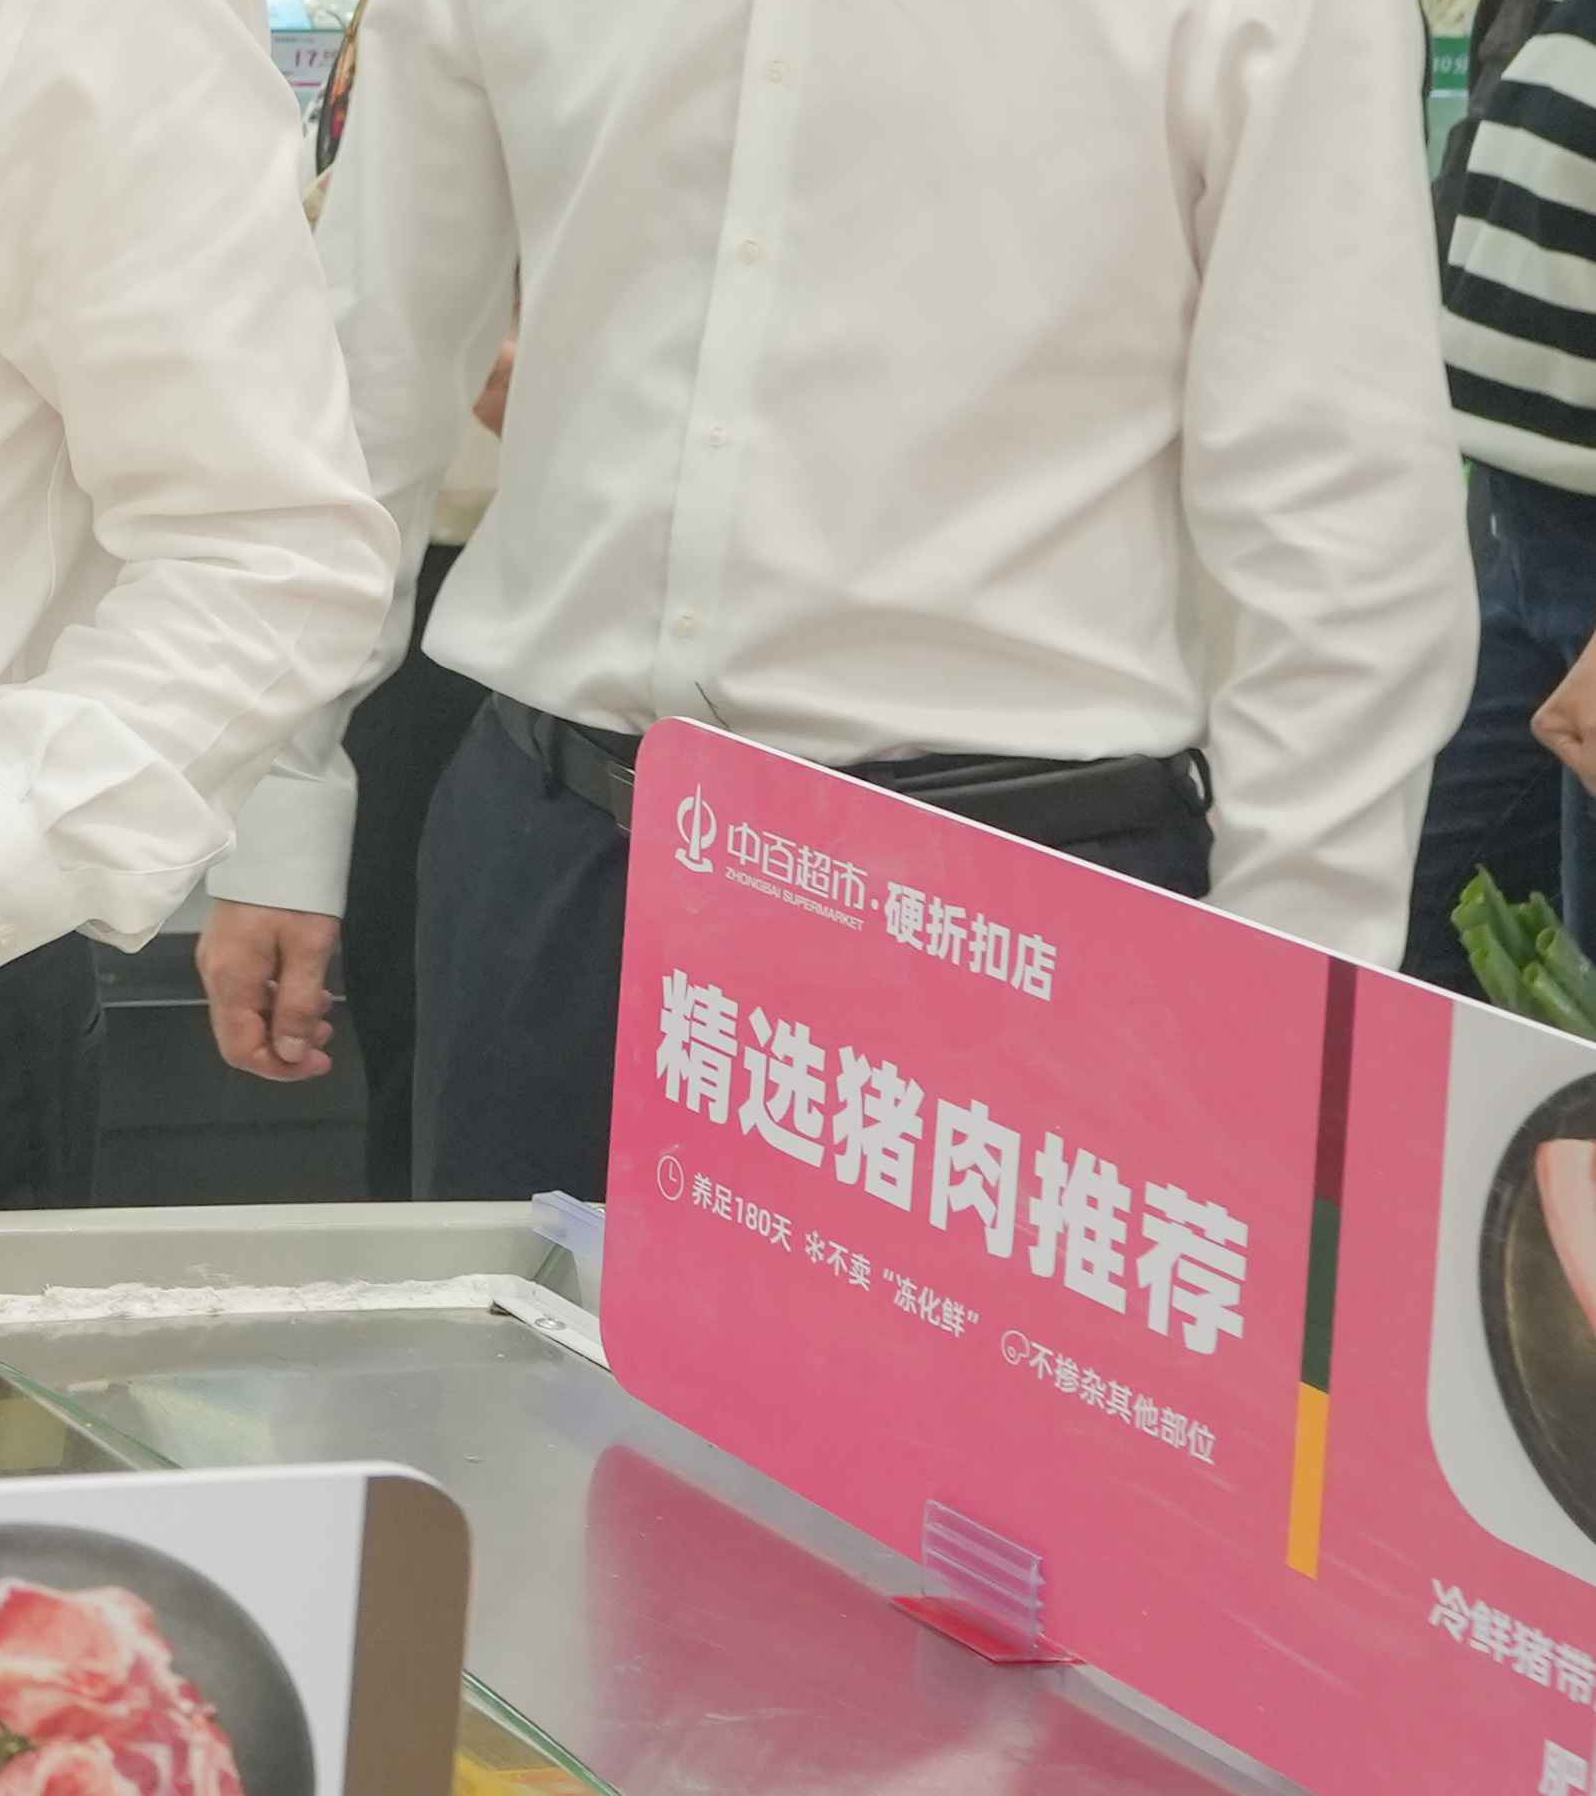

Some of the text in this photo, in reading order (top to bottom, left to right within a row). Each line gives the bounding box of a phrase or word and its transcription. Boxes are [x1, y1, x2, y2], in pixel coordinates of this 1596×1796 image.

[725, 866, 865, 933] ZHONGBAI SUPERMARKET
[655, 968, 1250, 1358] 精选猪肉推荐
[691, 1171, 793, 1253] 养足180天
[825, 1240, 872, 1292] 不卖
[1029, 1340, 1215, 1465] 不掺杂其他部位
[1428, 1577, 1596, 1707] 冷鲜猪带
